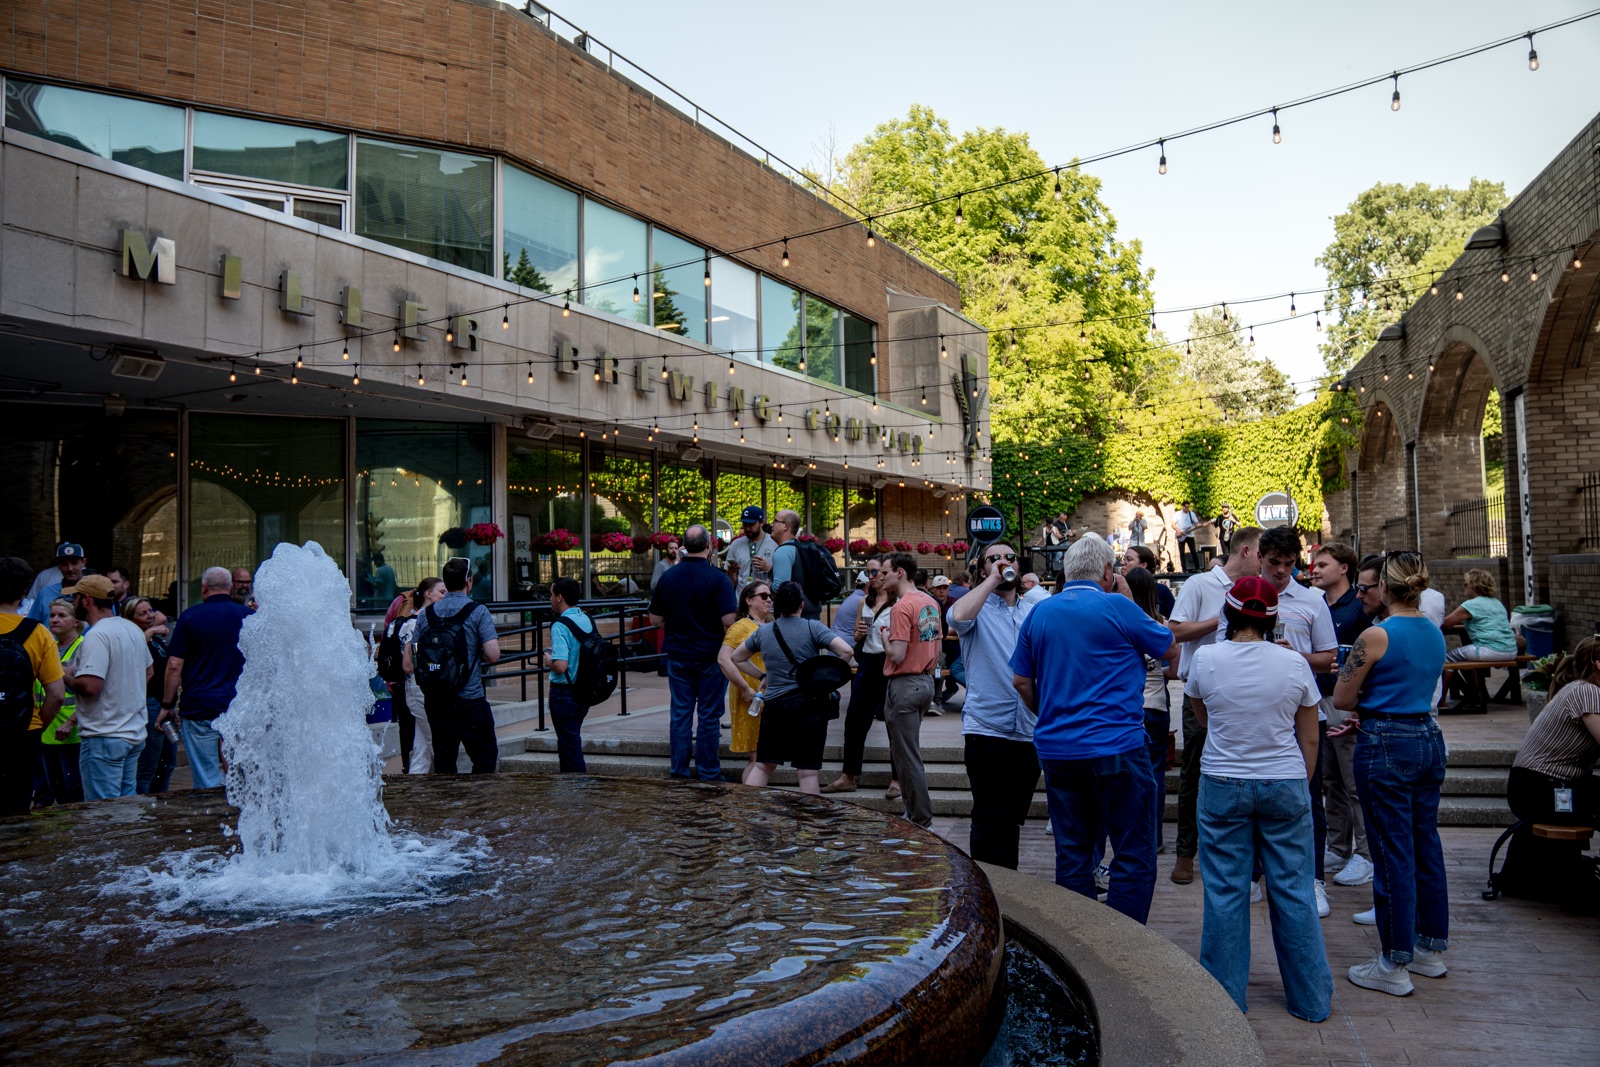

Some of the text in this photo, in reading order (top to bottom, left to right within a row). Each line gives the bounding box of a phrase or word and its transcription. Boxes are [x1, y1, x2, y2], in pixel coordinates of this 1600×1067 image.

[118, 229, 925, 455] MILLER BREWING COMPANY
[971, 519, 1002, 530] BAWKS
